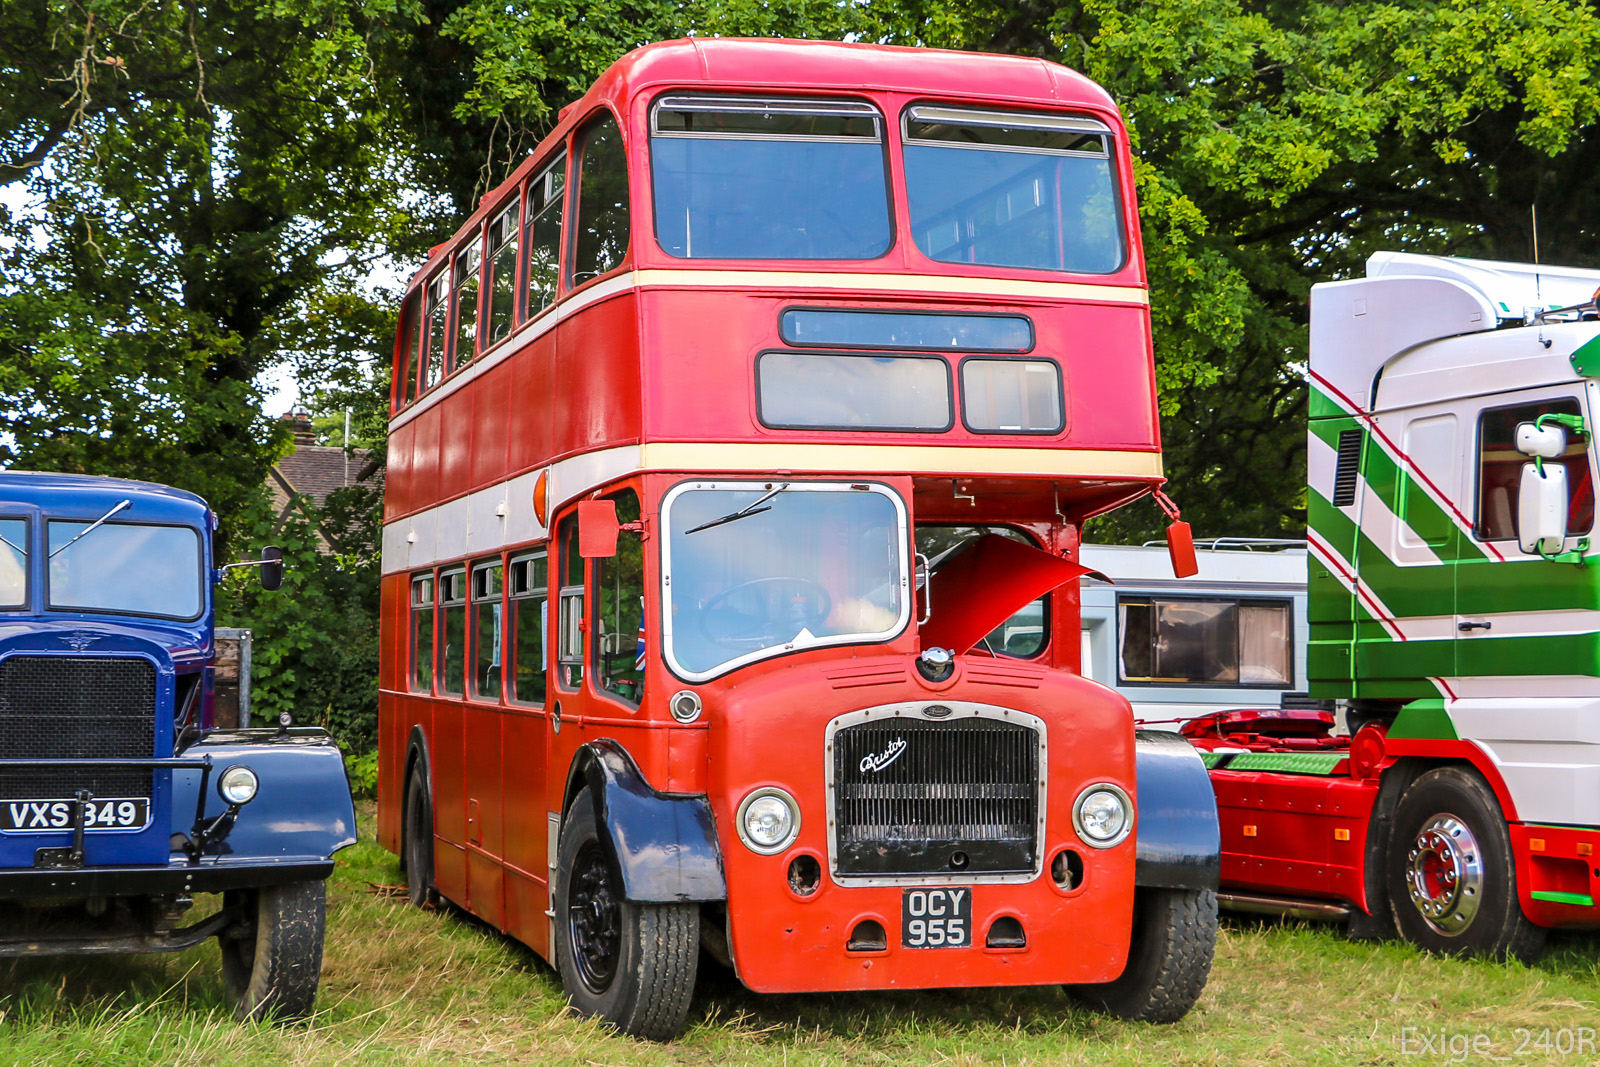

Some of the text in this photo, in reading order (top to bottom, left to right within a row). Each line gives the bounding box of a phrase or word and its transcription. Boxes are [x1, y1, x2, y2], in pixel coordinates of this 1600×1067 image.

[860, 736, 907, 772] Bristol
[9, 802, 70, 828] VXS
[908, 889, 965, 917] OCY
[908, 918, 965, 946] 955
